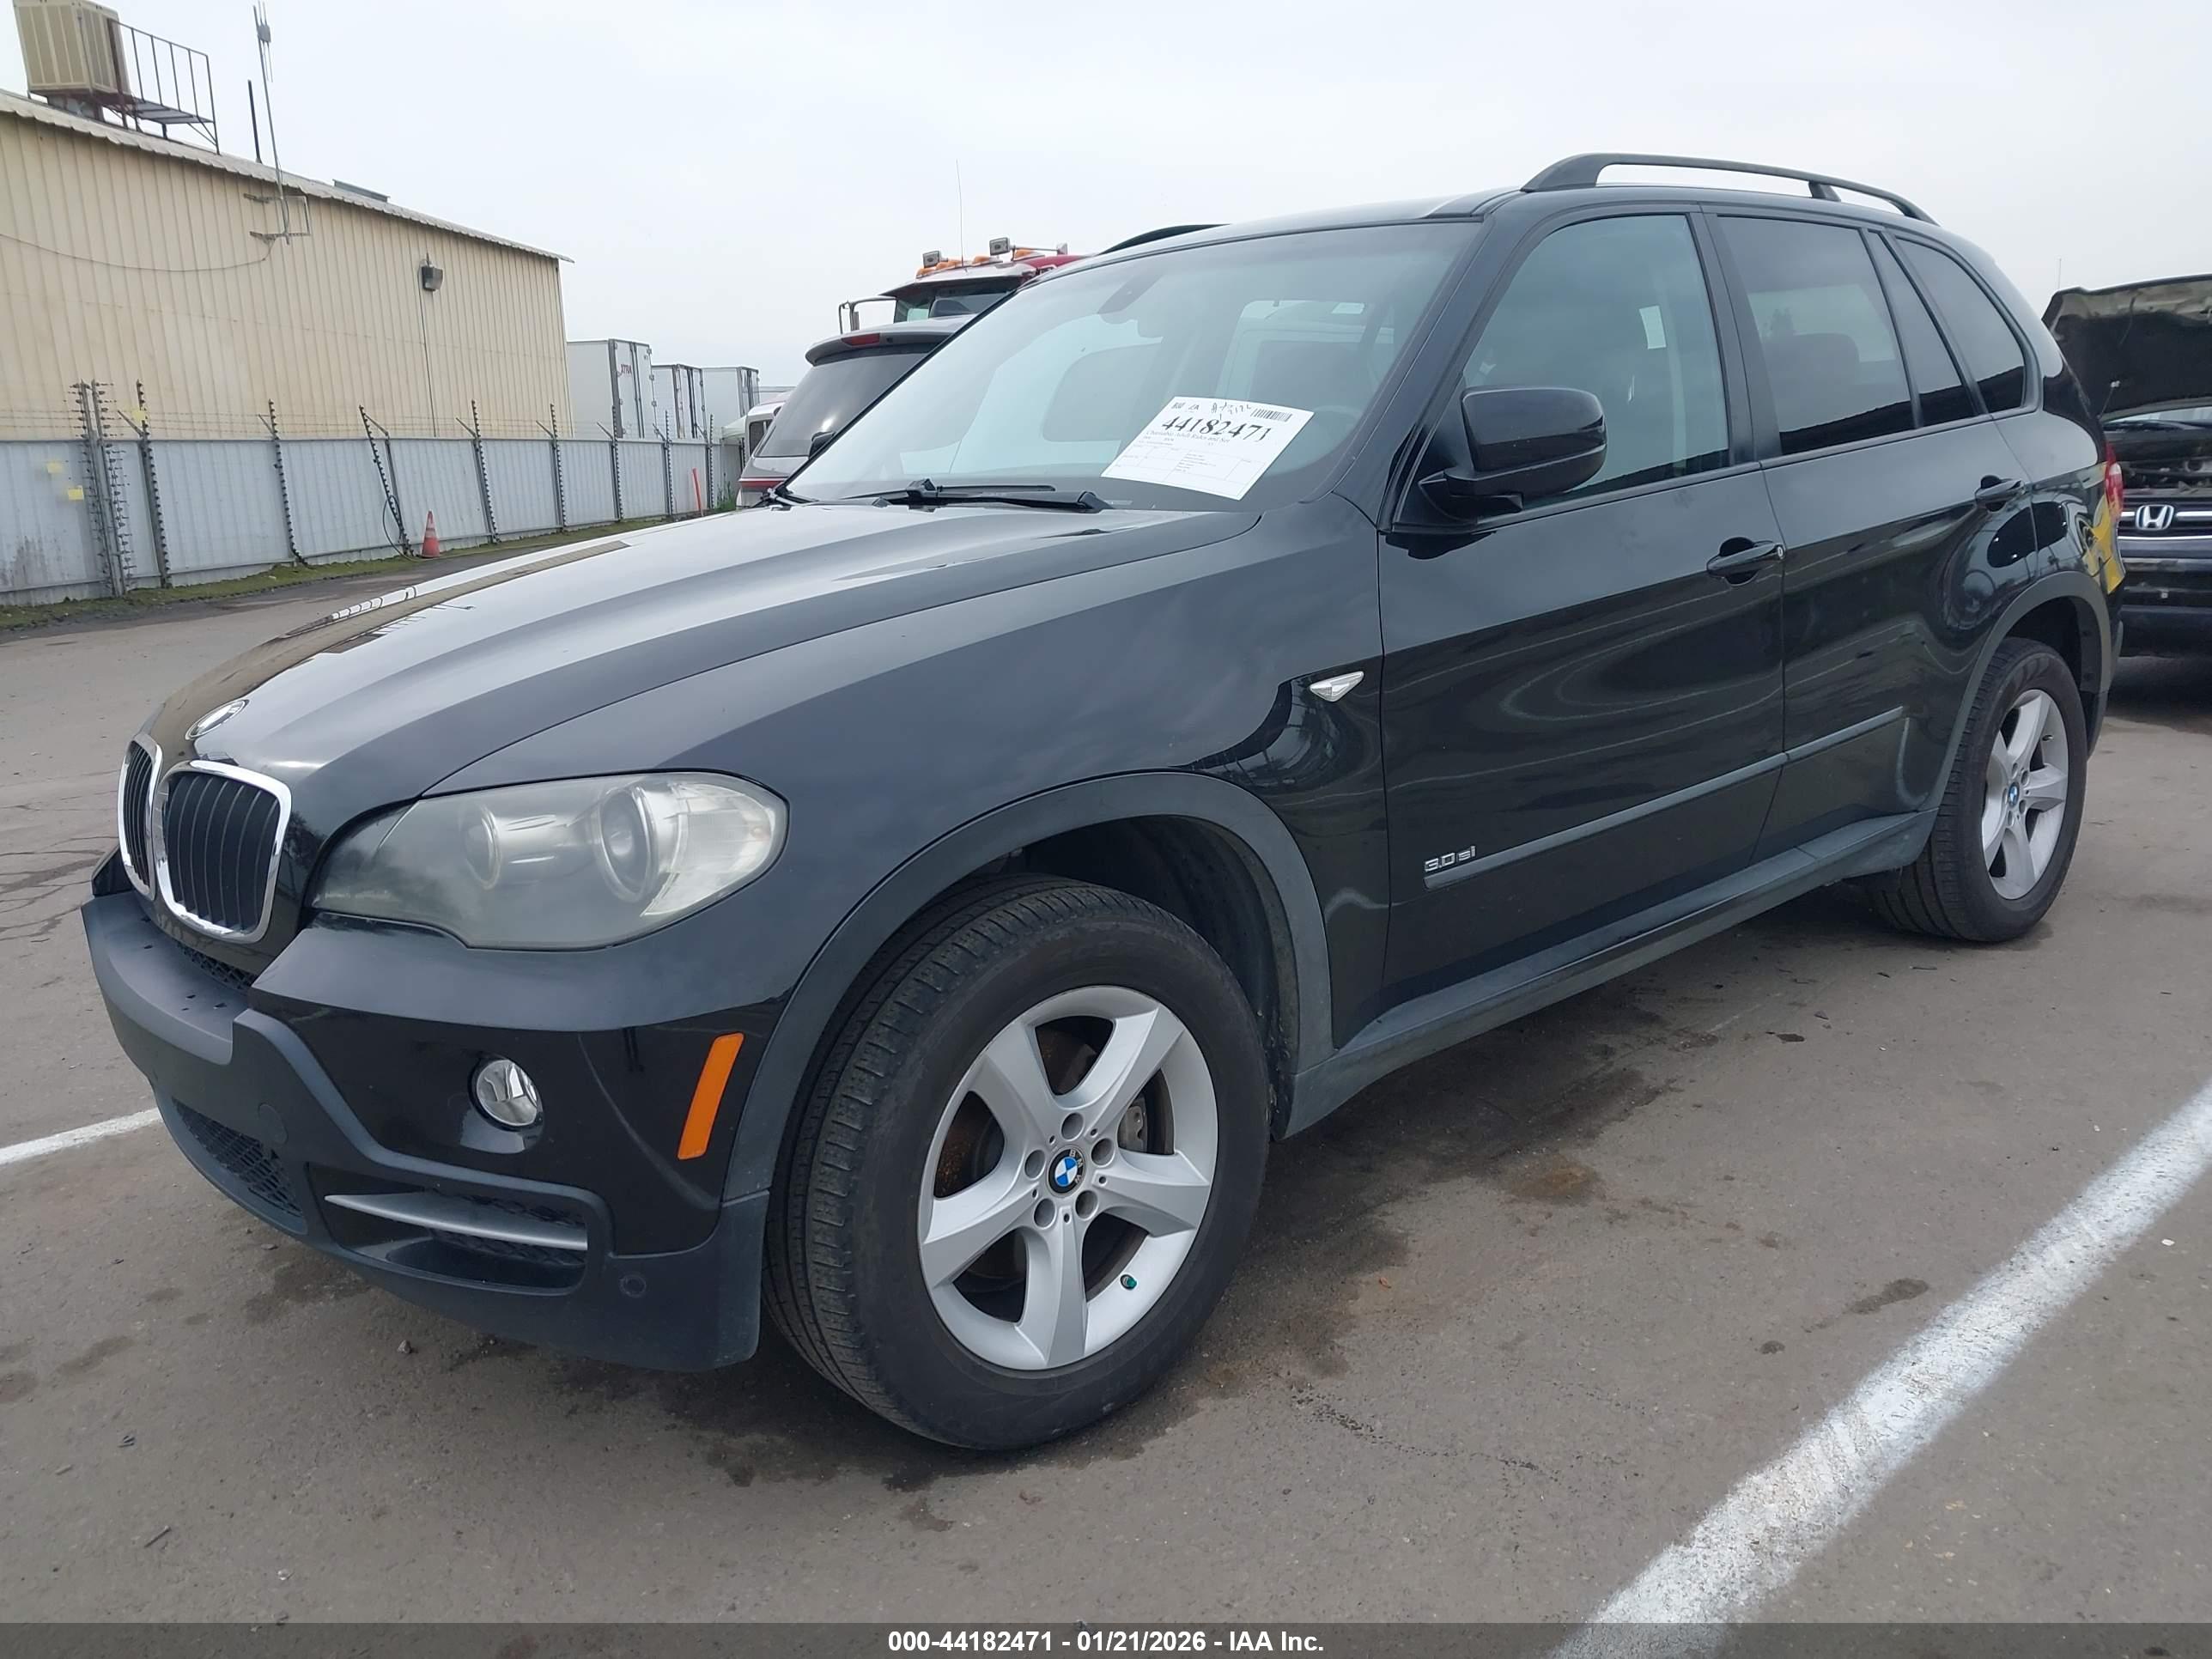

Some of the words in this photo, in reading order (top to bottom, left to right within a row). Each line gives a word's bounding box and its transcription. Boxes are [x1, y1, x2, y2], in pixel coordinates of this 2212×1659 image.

[621, 365, 632, 374] XTRA
[1162, 416, 1272, 442] 44182471
[1069, 1149, 1084, 1184] BMW
